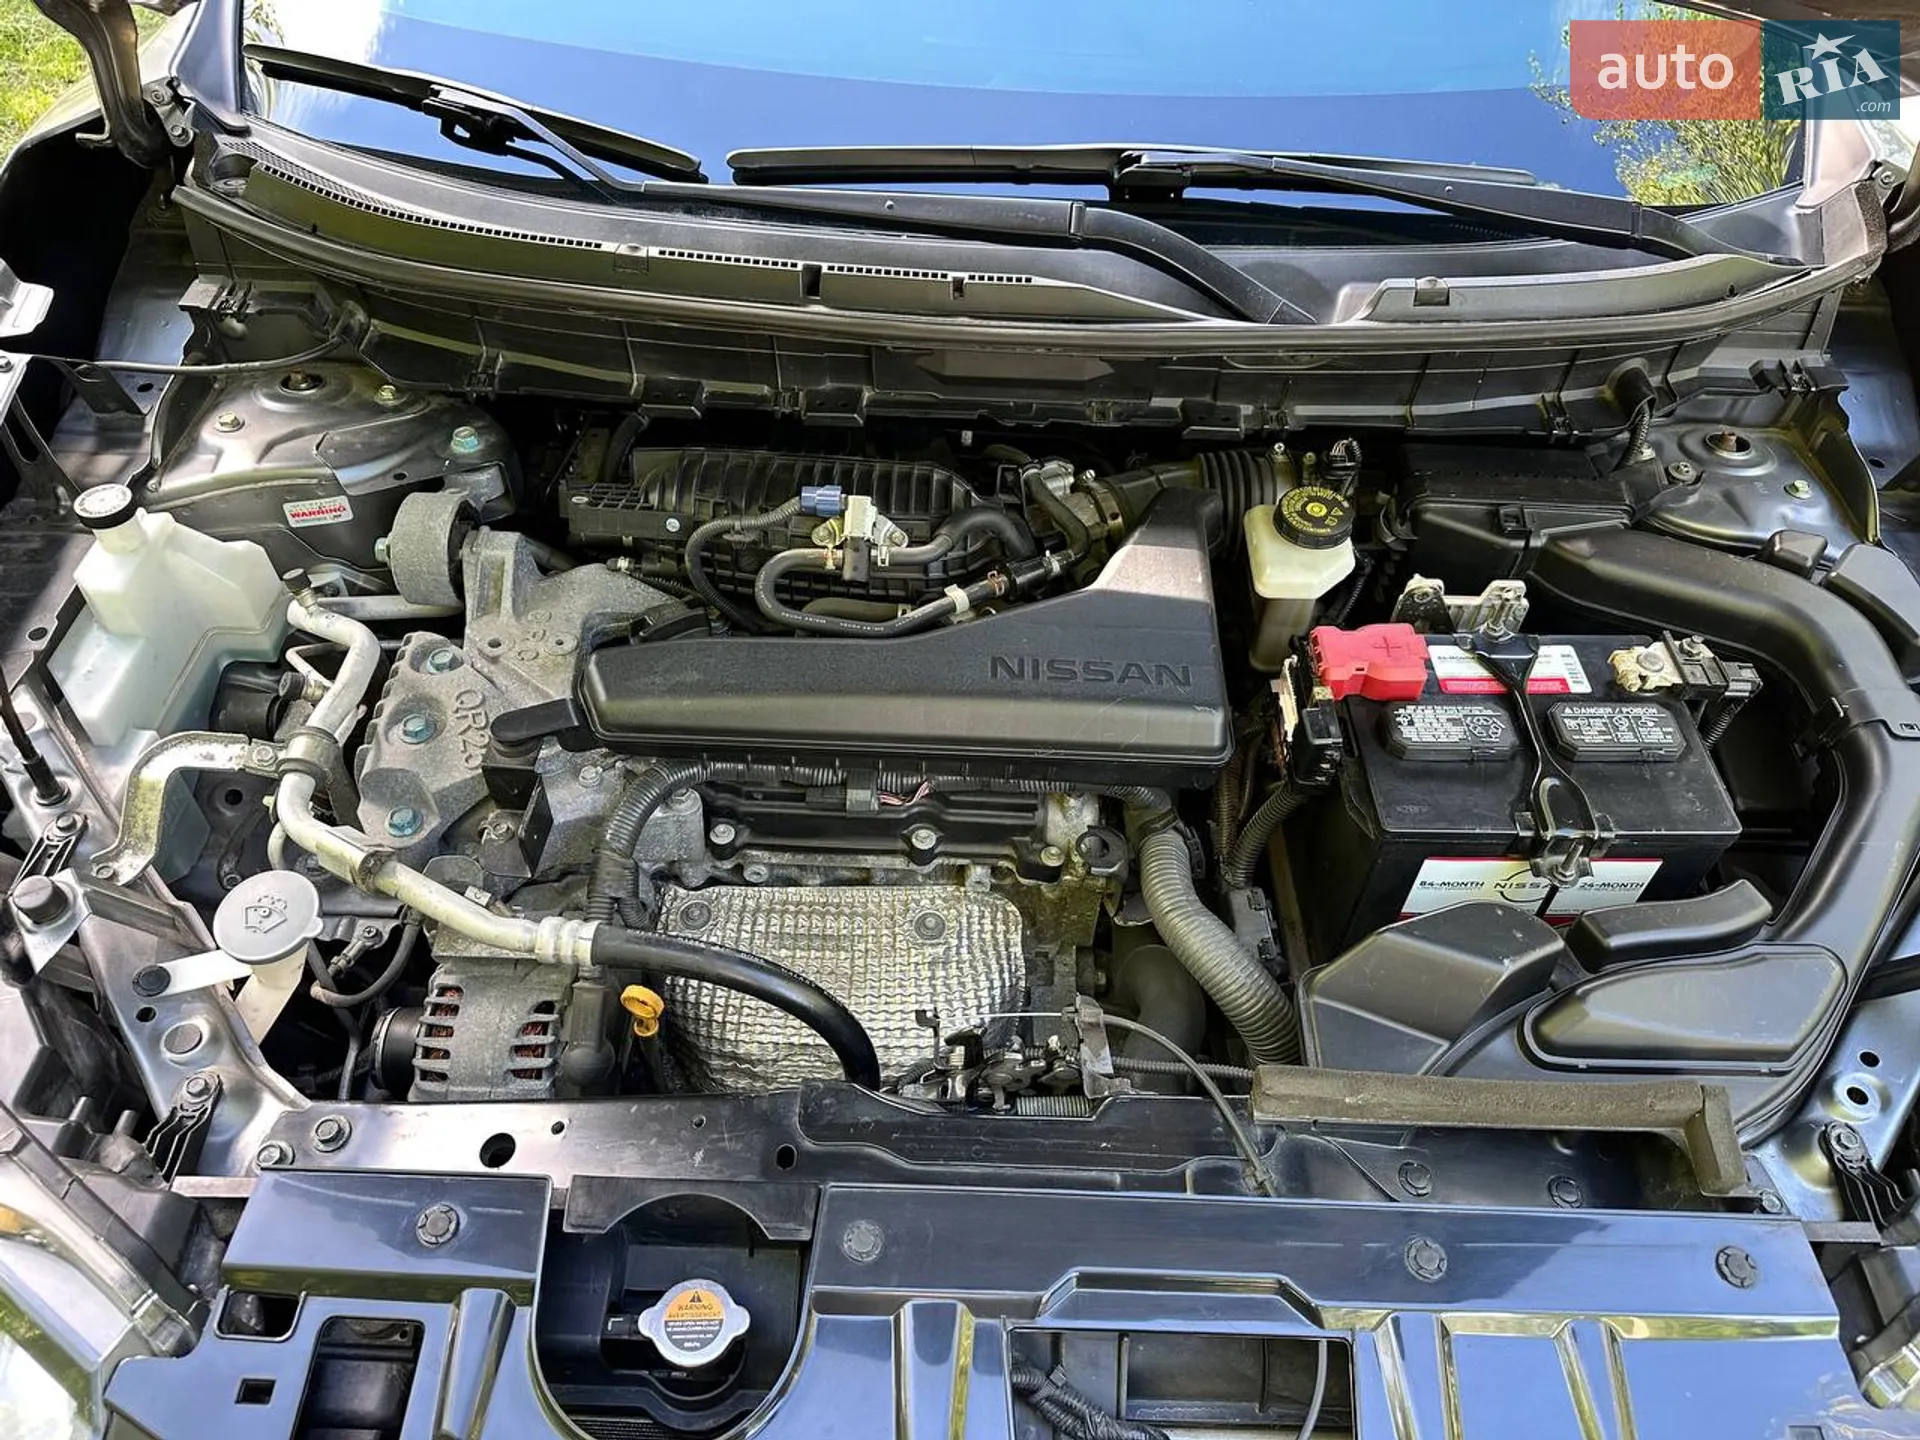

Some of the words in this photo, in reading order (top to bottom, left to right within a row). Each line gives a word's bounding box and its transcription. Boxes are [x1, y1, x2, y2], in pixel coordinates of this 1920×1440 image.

[289, 504, 346, 519] WARNING
[989, 655, 1192, 687] NISSAN
[1573, 706, 1613, 714] DANGER
[1621, 706, 1658, 715] POISON
[1419, 880, 1485, 888] 84-MONTH
[1580, 881, 1645, 889] 24-MONTH
[677, 1303, 714, 1312] WARNING
